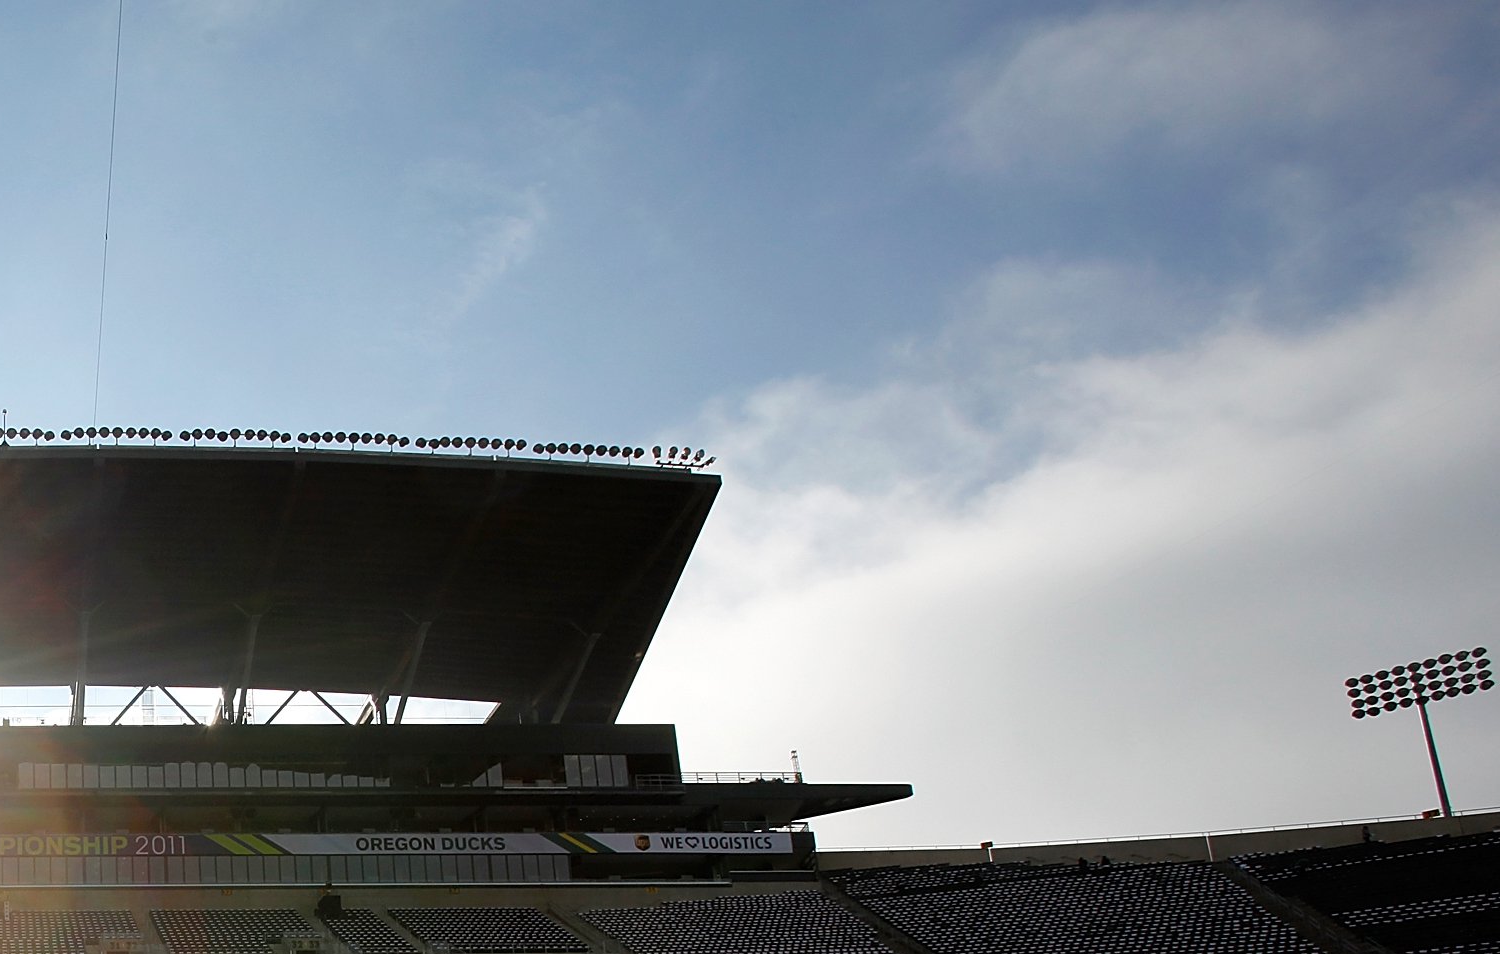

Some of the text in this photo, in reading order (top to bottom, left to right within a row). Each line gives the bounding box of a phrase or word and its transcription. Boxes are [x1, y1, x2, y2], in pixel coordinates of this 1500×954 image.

[135, 836, 185, 855] 2011
[356, 837, 506, 851] OREGON DUCKS
[661, 836, 772, 849] WE LOGISTICS
